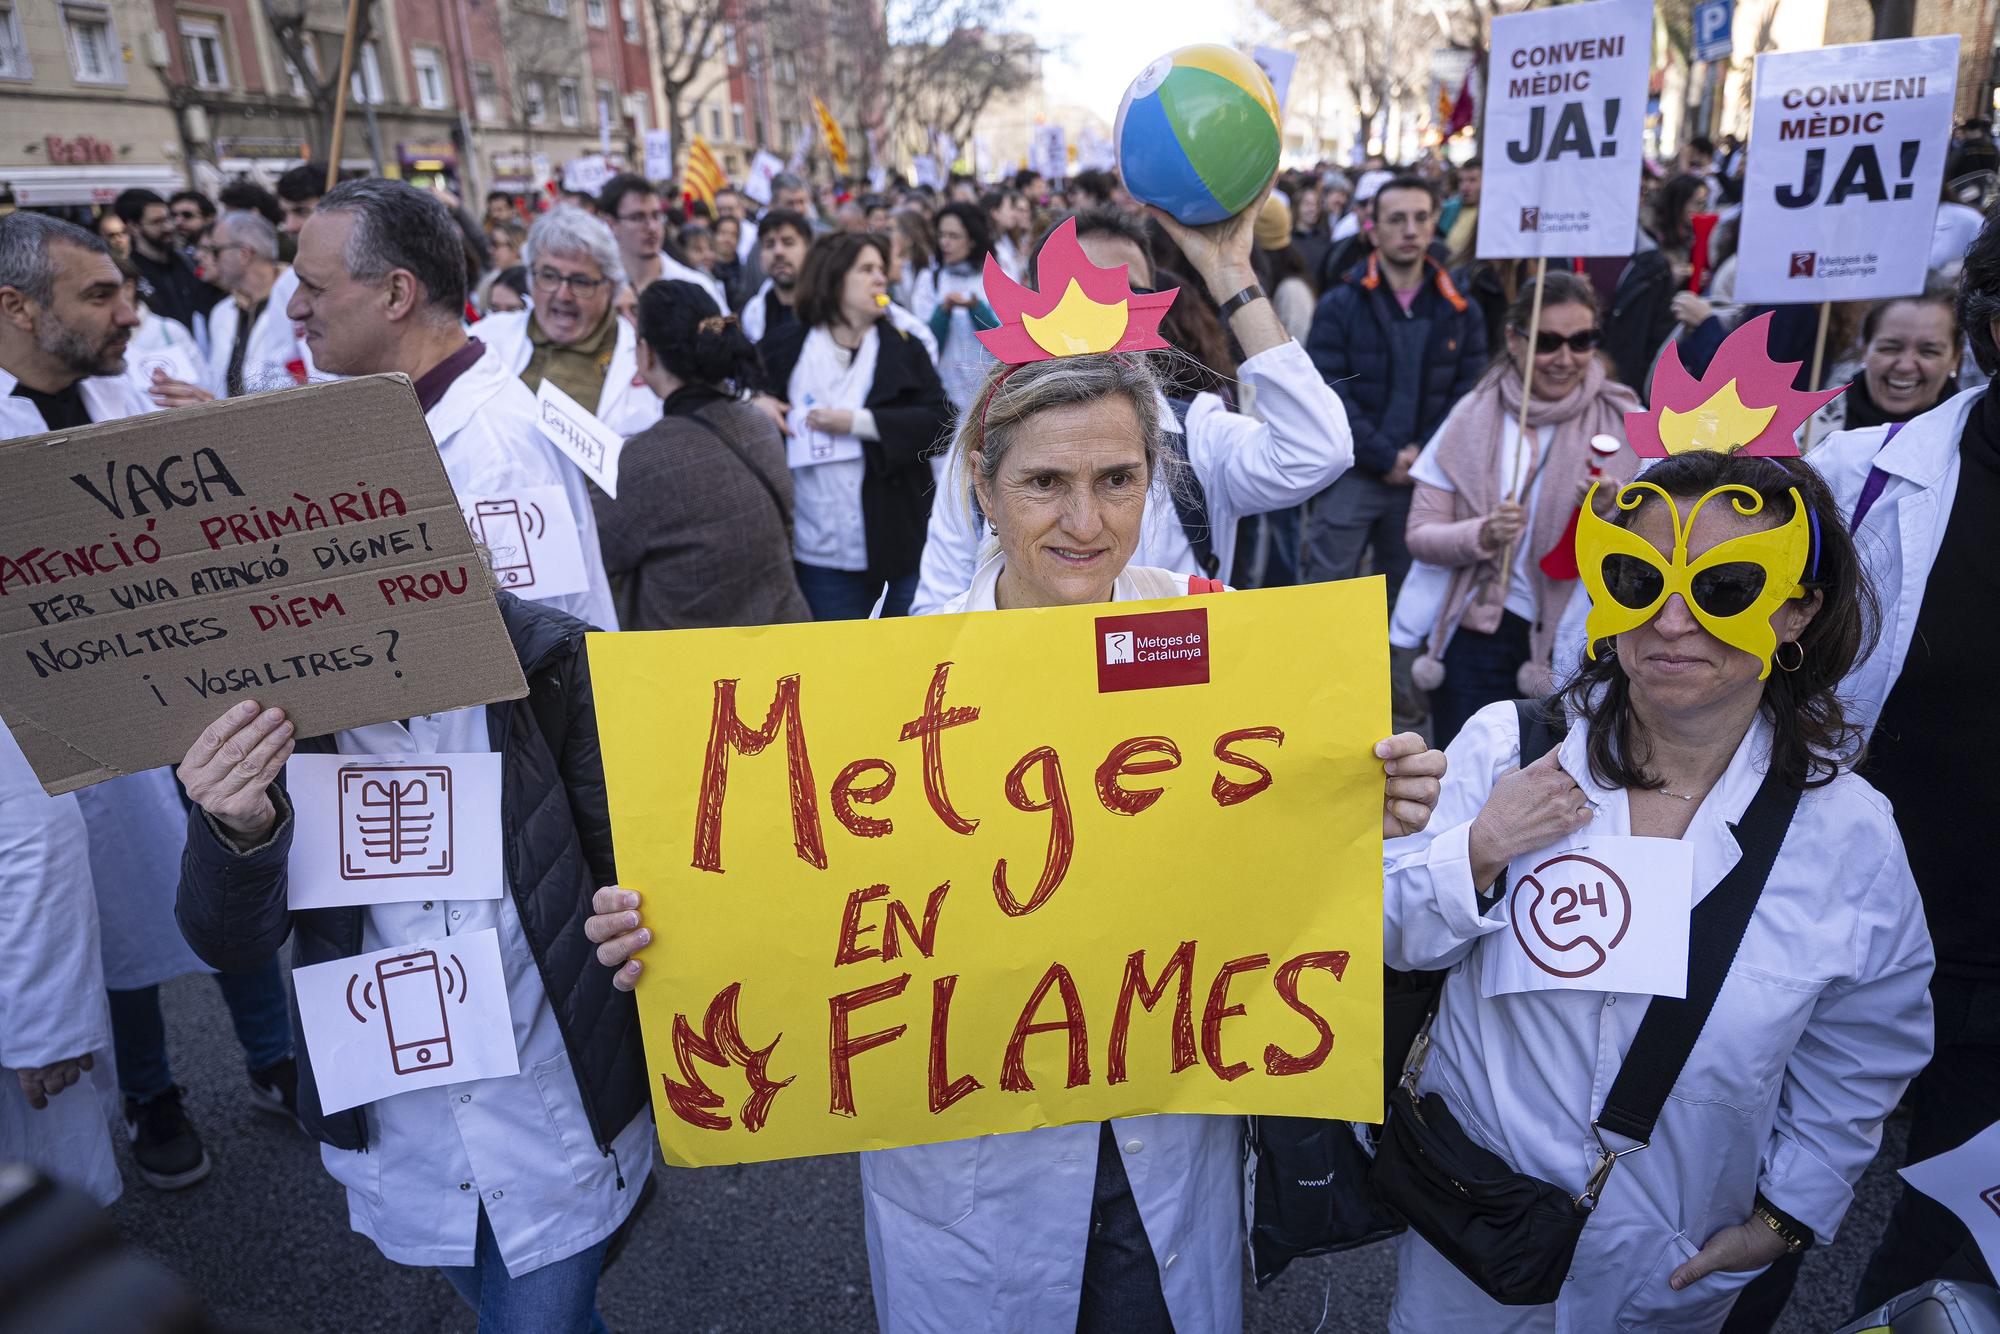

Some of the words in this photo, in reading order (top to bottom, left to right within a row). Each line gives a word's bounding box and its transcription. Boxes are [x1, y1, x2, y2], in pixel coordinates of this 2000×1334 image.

[1702, 5, 1727, 42] P
[1511, 35, 1625, 69] CONVENI
[1509, 70, 1590, 99] MÈDIC
[1782, 76, 1927, 110] CONVENI
[1506, 98, 1620, 165] JA!
[1779, 111, 1885, 141] MÈDIC
[1774, 139, 1921, 210] JA!
[1818, 265, 1877, 278] Catalunya
[69, 447, 246, 520] VAGA
[26, 617, 228, 678] NOSALTRES
[378, 566, 468, 606] PROU
[28, 594, 96, 626] PER
[110, 577, 179, 610] UNA
[1136, 636, 1183, 650] Metges
[1185, 632, 1201, 644] de
[1137, 647, 1201, 662] Catalunya
[691, 661, 1284, 917] Metges
[834, 879, 950, 968] EN
[1551, 882, 1607, 925] 24
[829, 940, 1350, 1116] FLAMES
